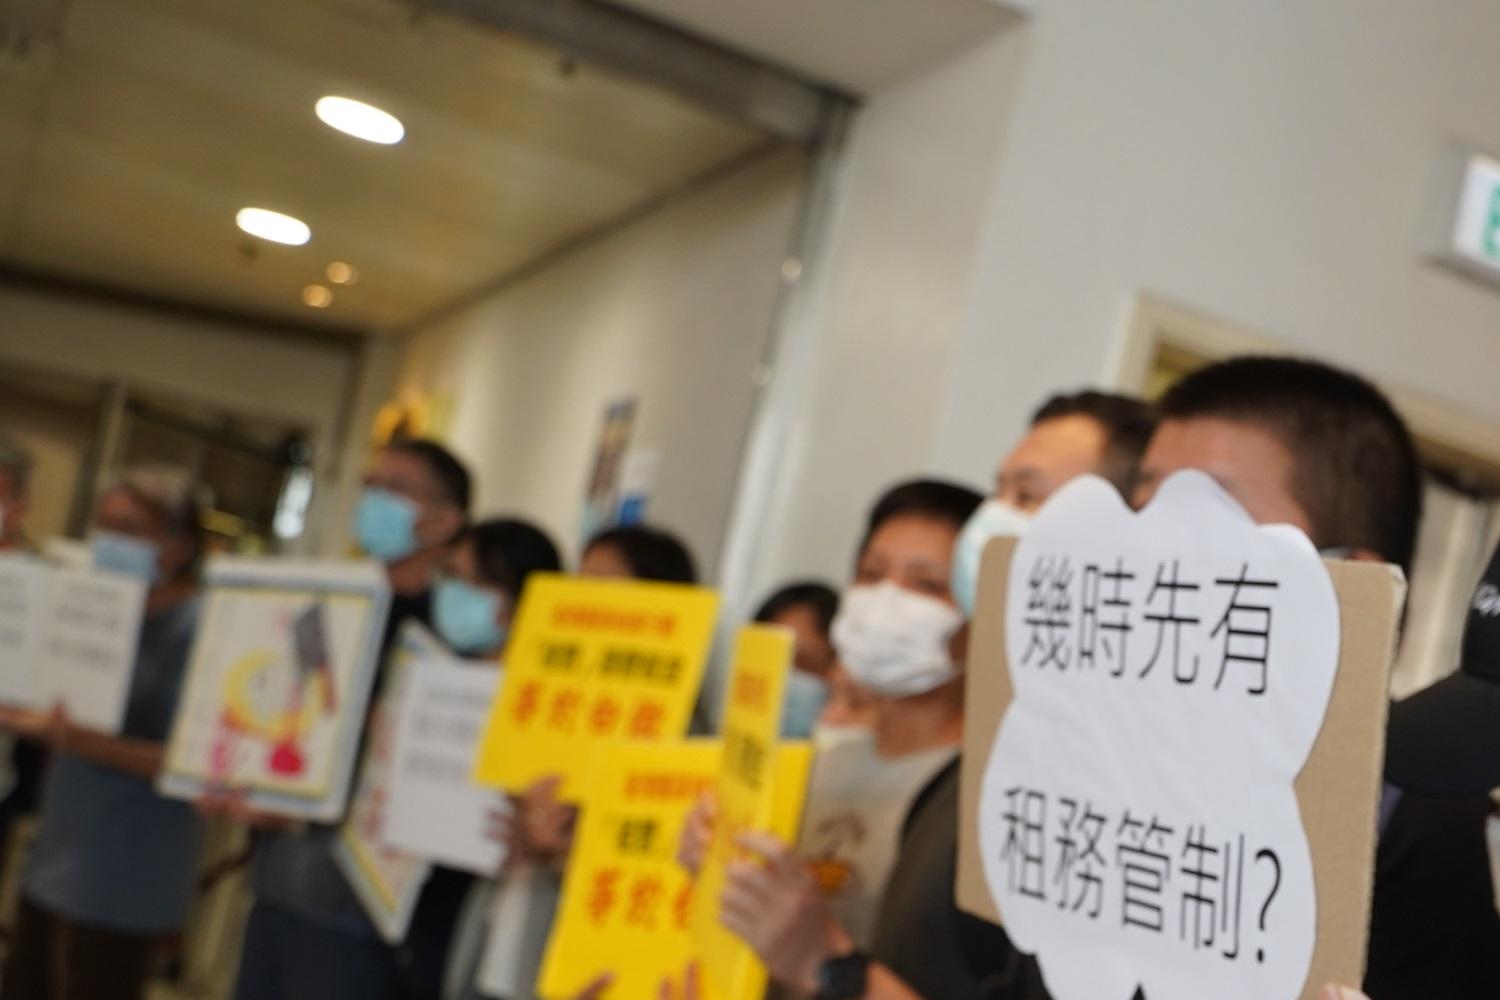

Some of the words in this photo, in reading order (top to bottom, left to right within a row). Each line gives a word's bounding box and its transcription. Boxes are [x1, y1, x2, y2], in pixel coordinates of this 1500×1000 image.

[1021, 555, 1280, 695] 幾時先有
[1000, 784, 1281, 965] 租務管制?
